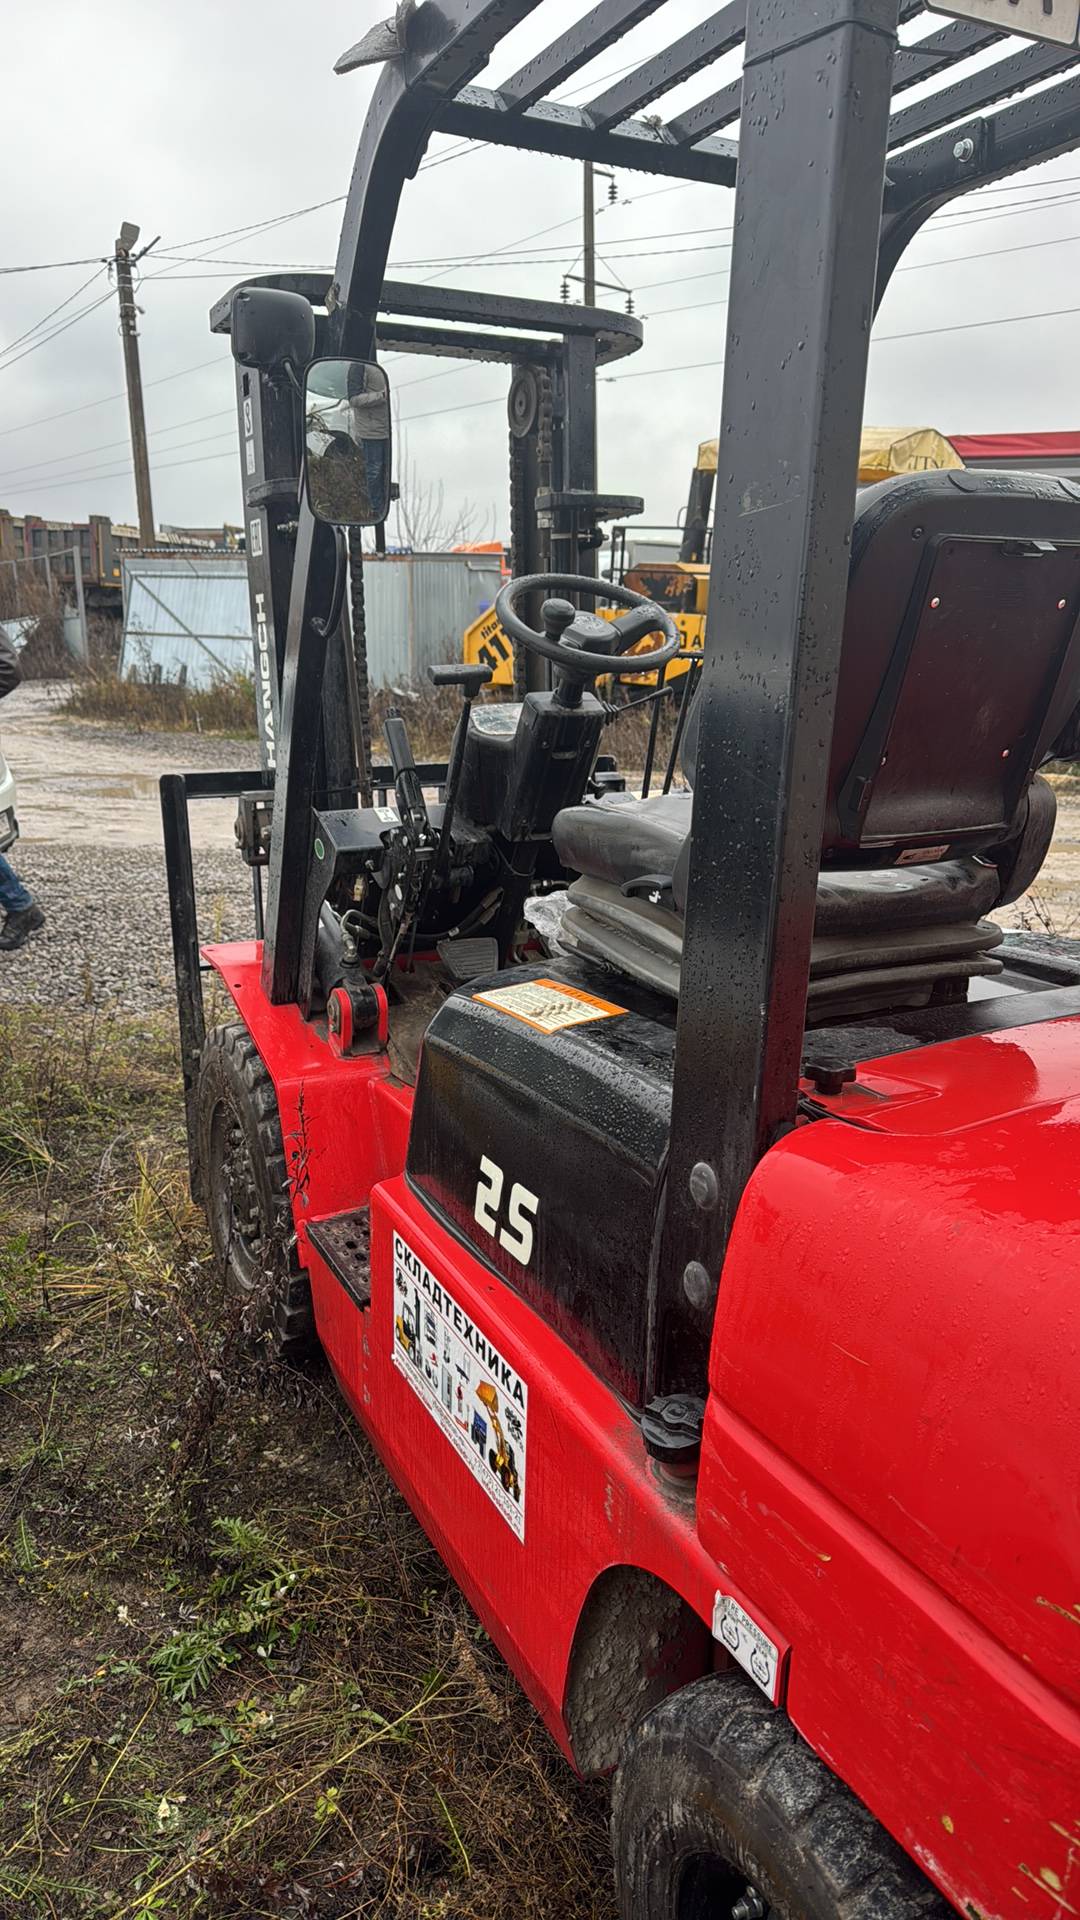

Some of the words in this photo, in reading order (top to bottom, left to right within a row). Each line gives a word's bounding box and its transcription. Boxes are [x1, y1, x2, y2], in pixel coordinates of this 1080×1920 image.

[255, 593, 276, 768] HANGCH
[478, 629, 513, 671] 41
[481, 621, 498, 639] tita
[474, 1154, 539, 1266] 25
[395, 1237, 525, 1410] СКЛАДТЕХНИКА
